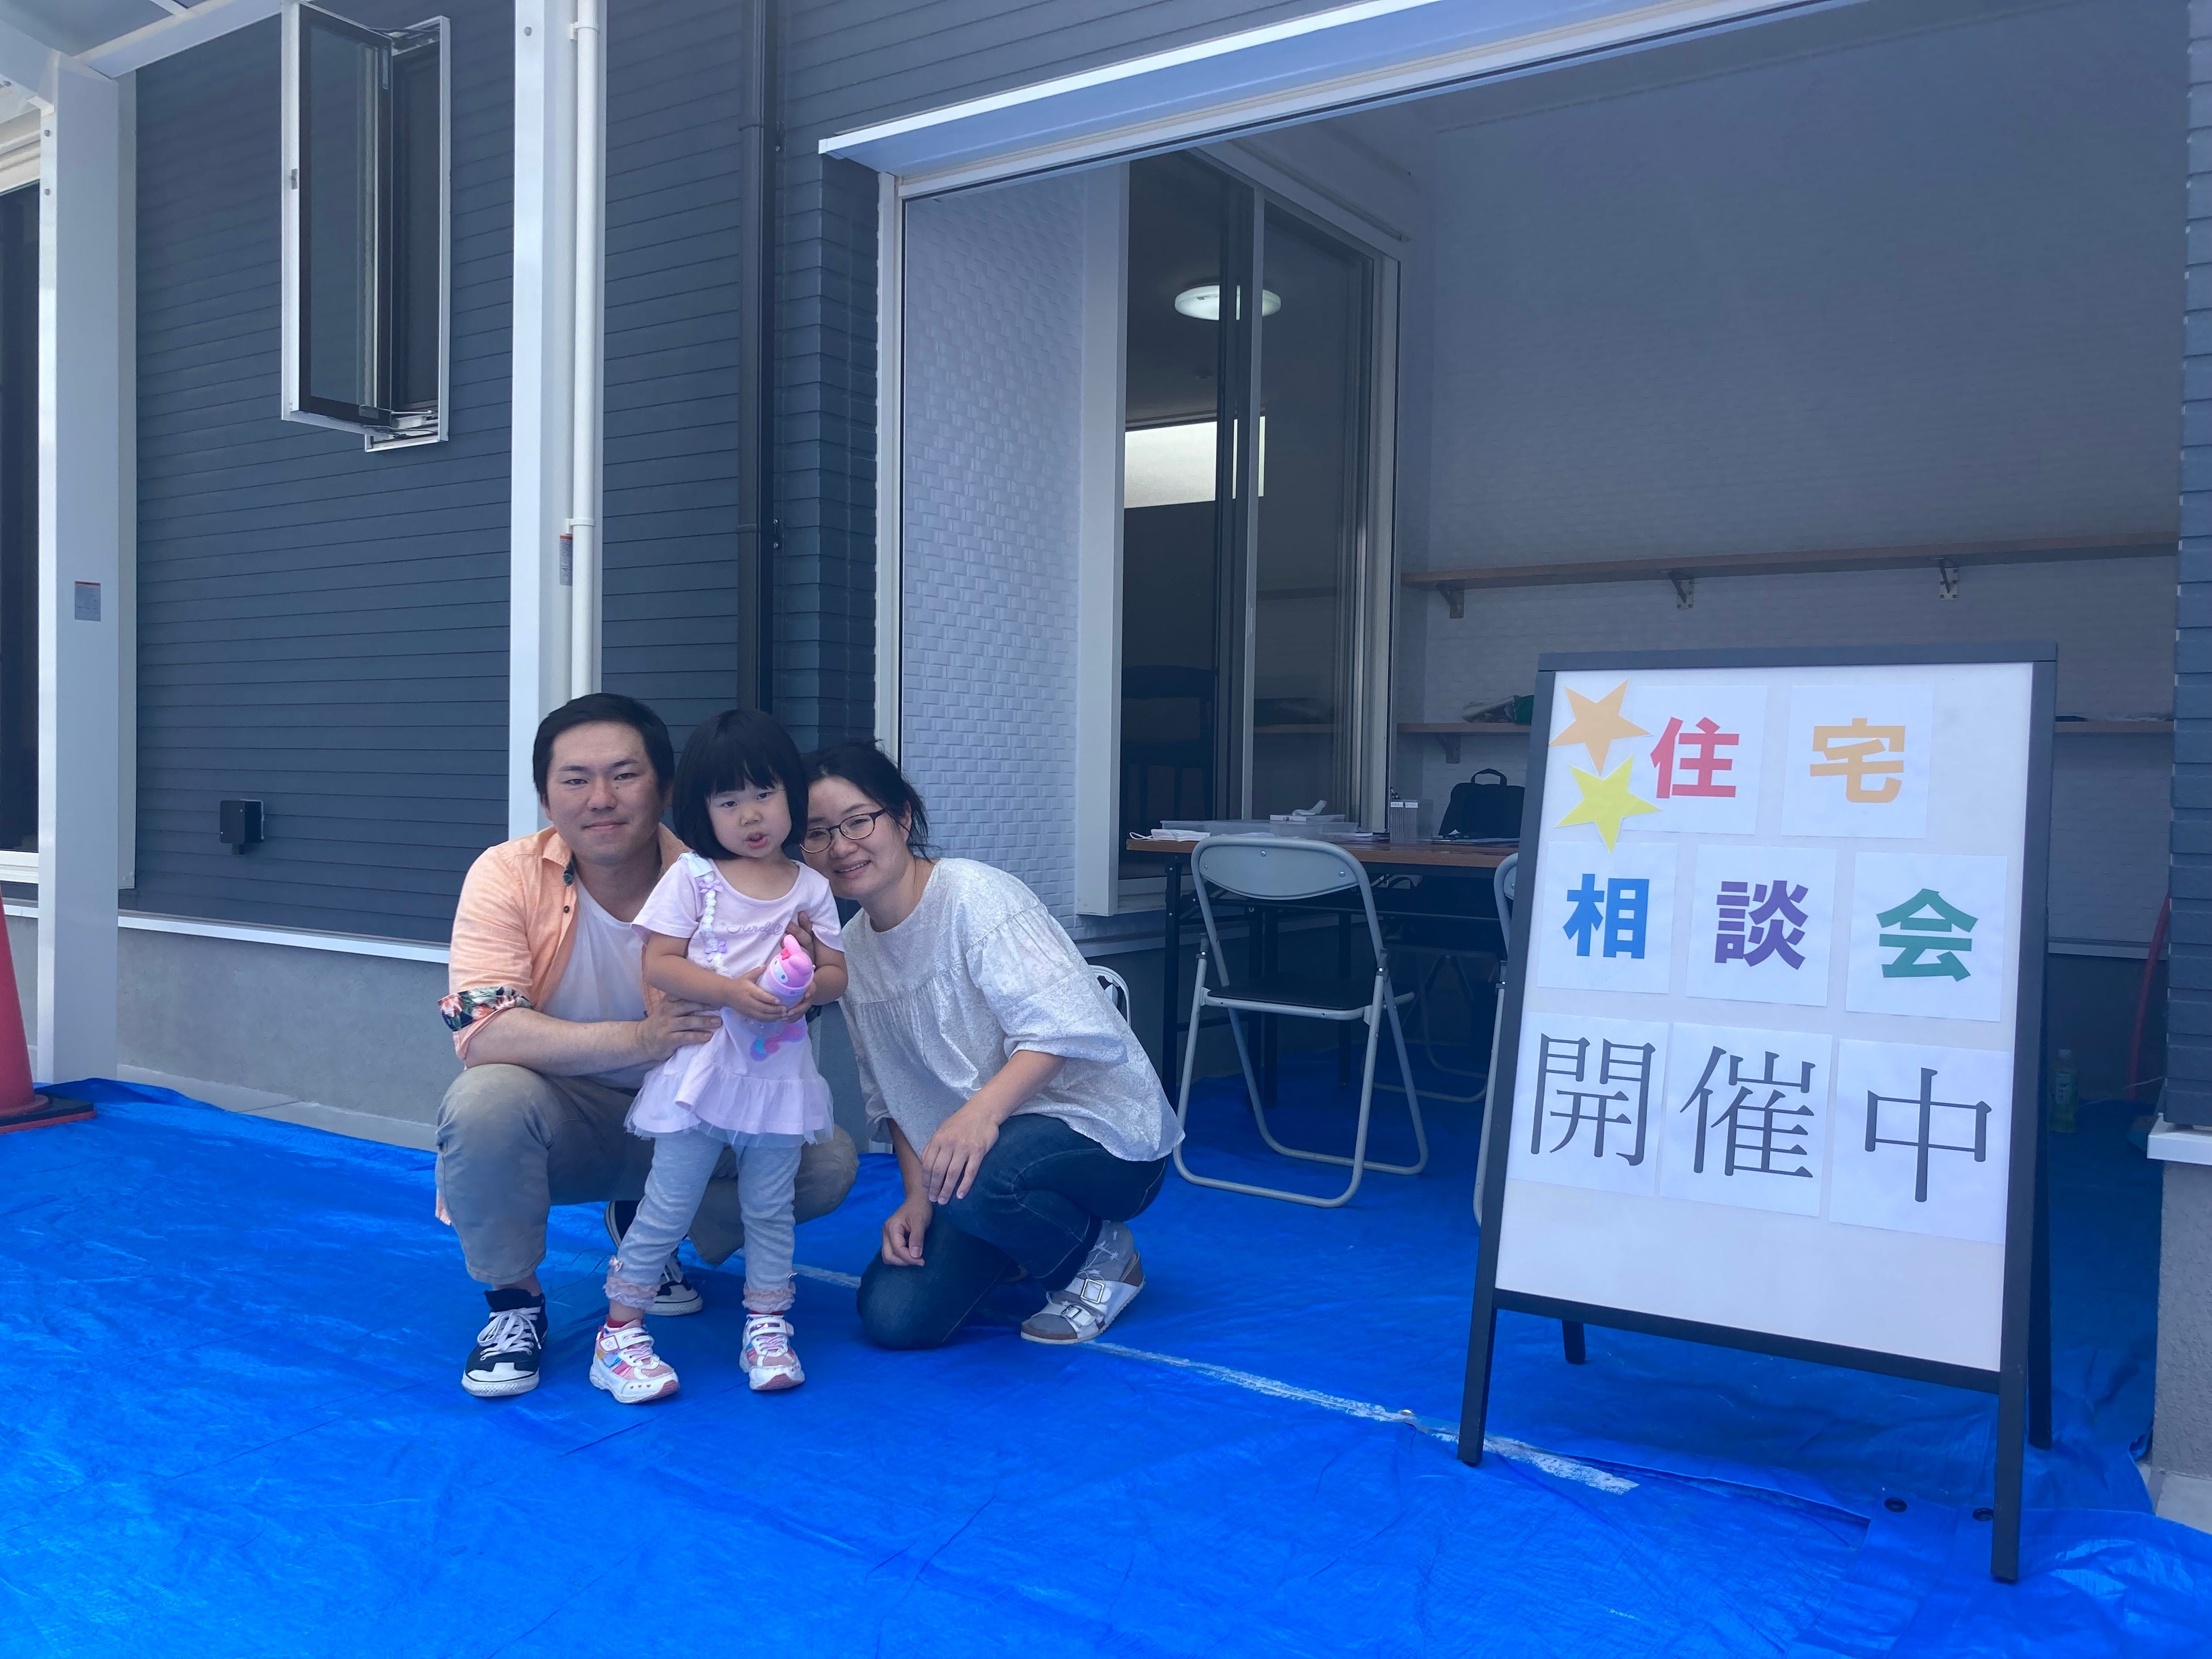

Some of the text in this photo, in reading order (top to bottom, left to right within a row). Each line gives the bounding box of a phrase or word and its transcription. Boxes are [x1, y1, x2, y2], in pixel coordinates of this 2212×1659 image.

[1650, 716, 1905, 803] 住宅
[1563, 874, 1978, 982] 相談会
[1531, 1033, 1991, 1202] 開催中
